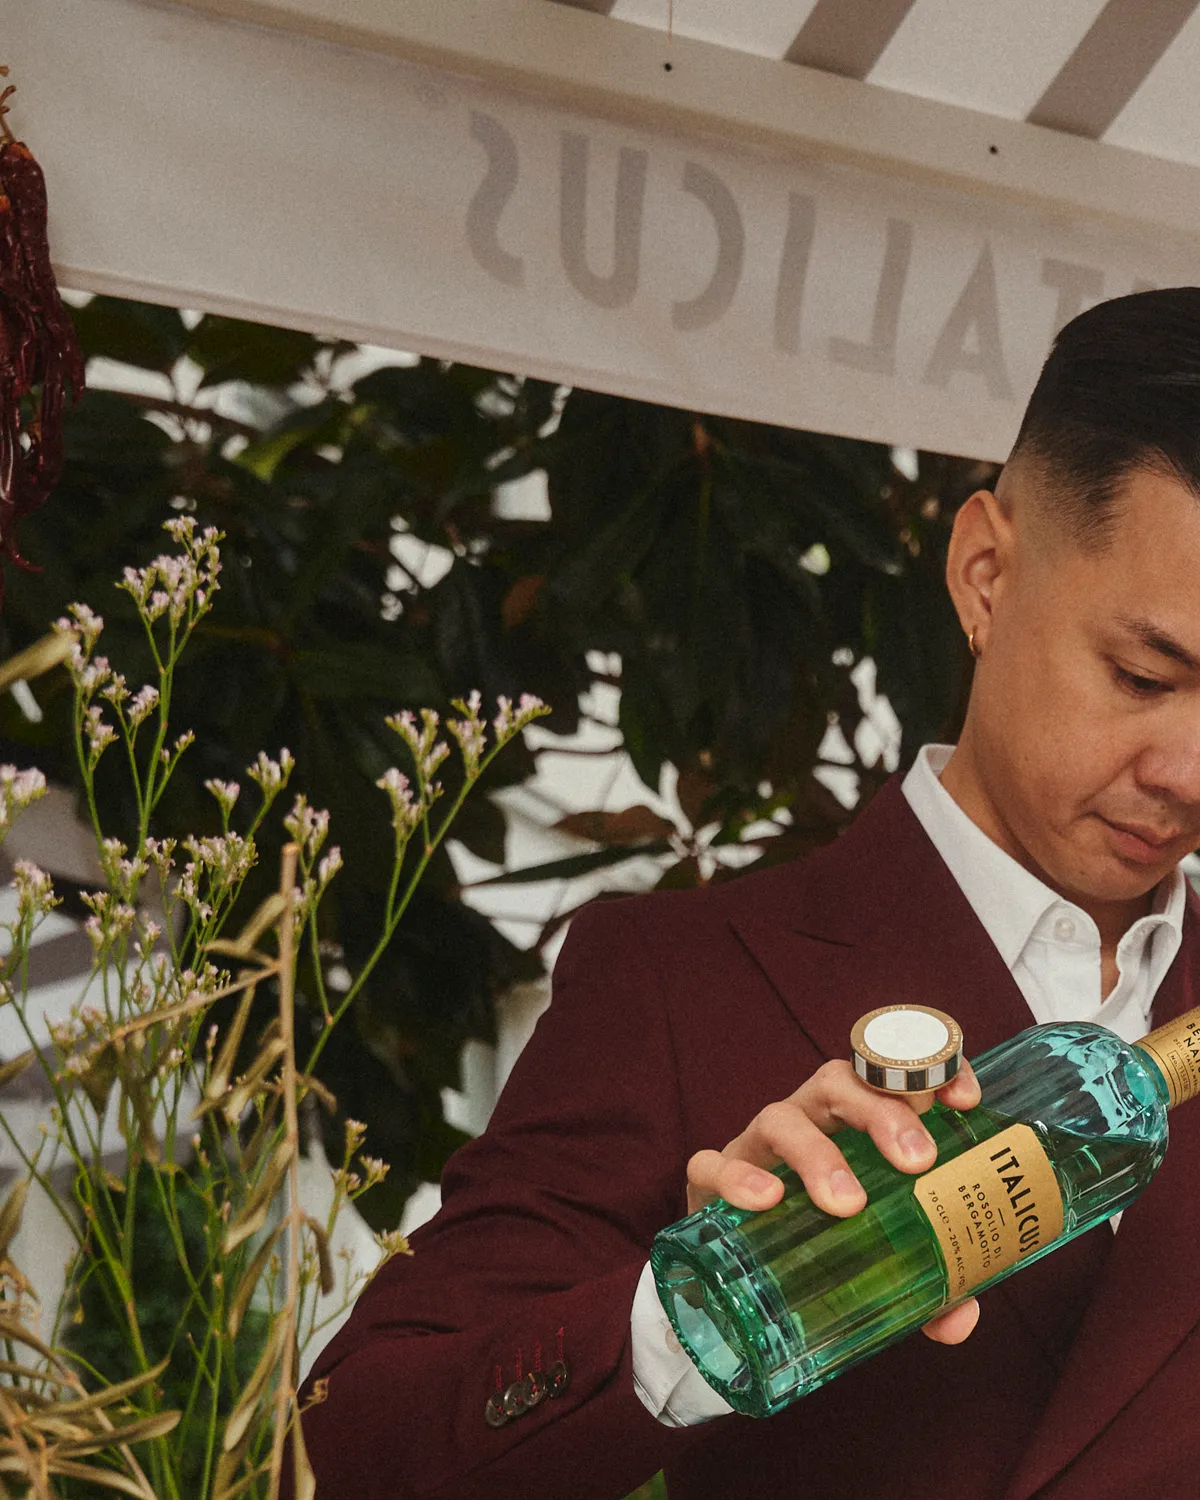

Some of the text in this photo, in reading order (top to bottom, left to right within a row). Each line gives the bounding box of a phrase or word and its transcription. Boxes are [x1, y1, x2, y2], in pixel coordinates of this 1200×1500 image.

[927, 1189, 939, 1203] 70
[948, 1234, 962, 1255] 20%
[957, 1184, 991, 1268] BERGAMOTTO
[971, 1182, 1002, 1258] ROSOLIO DI
[988, 1146, 1039, 1253] ITALICUS
